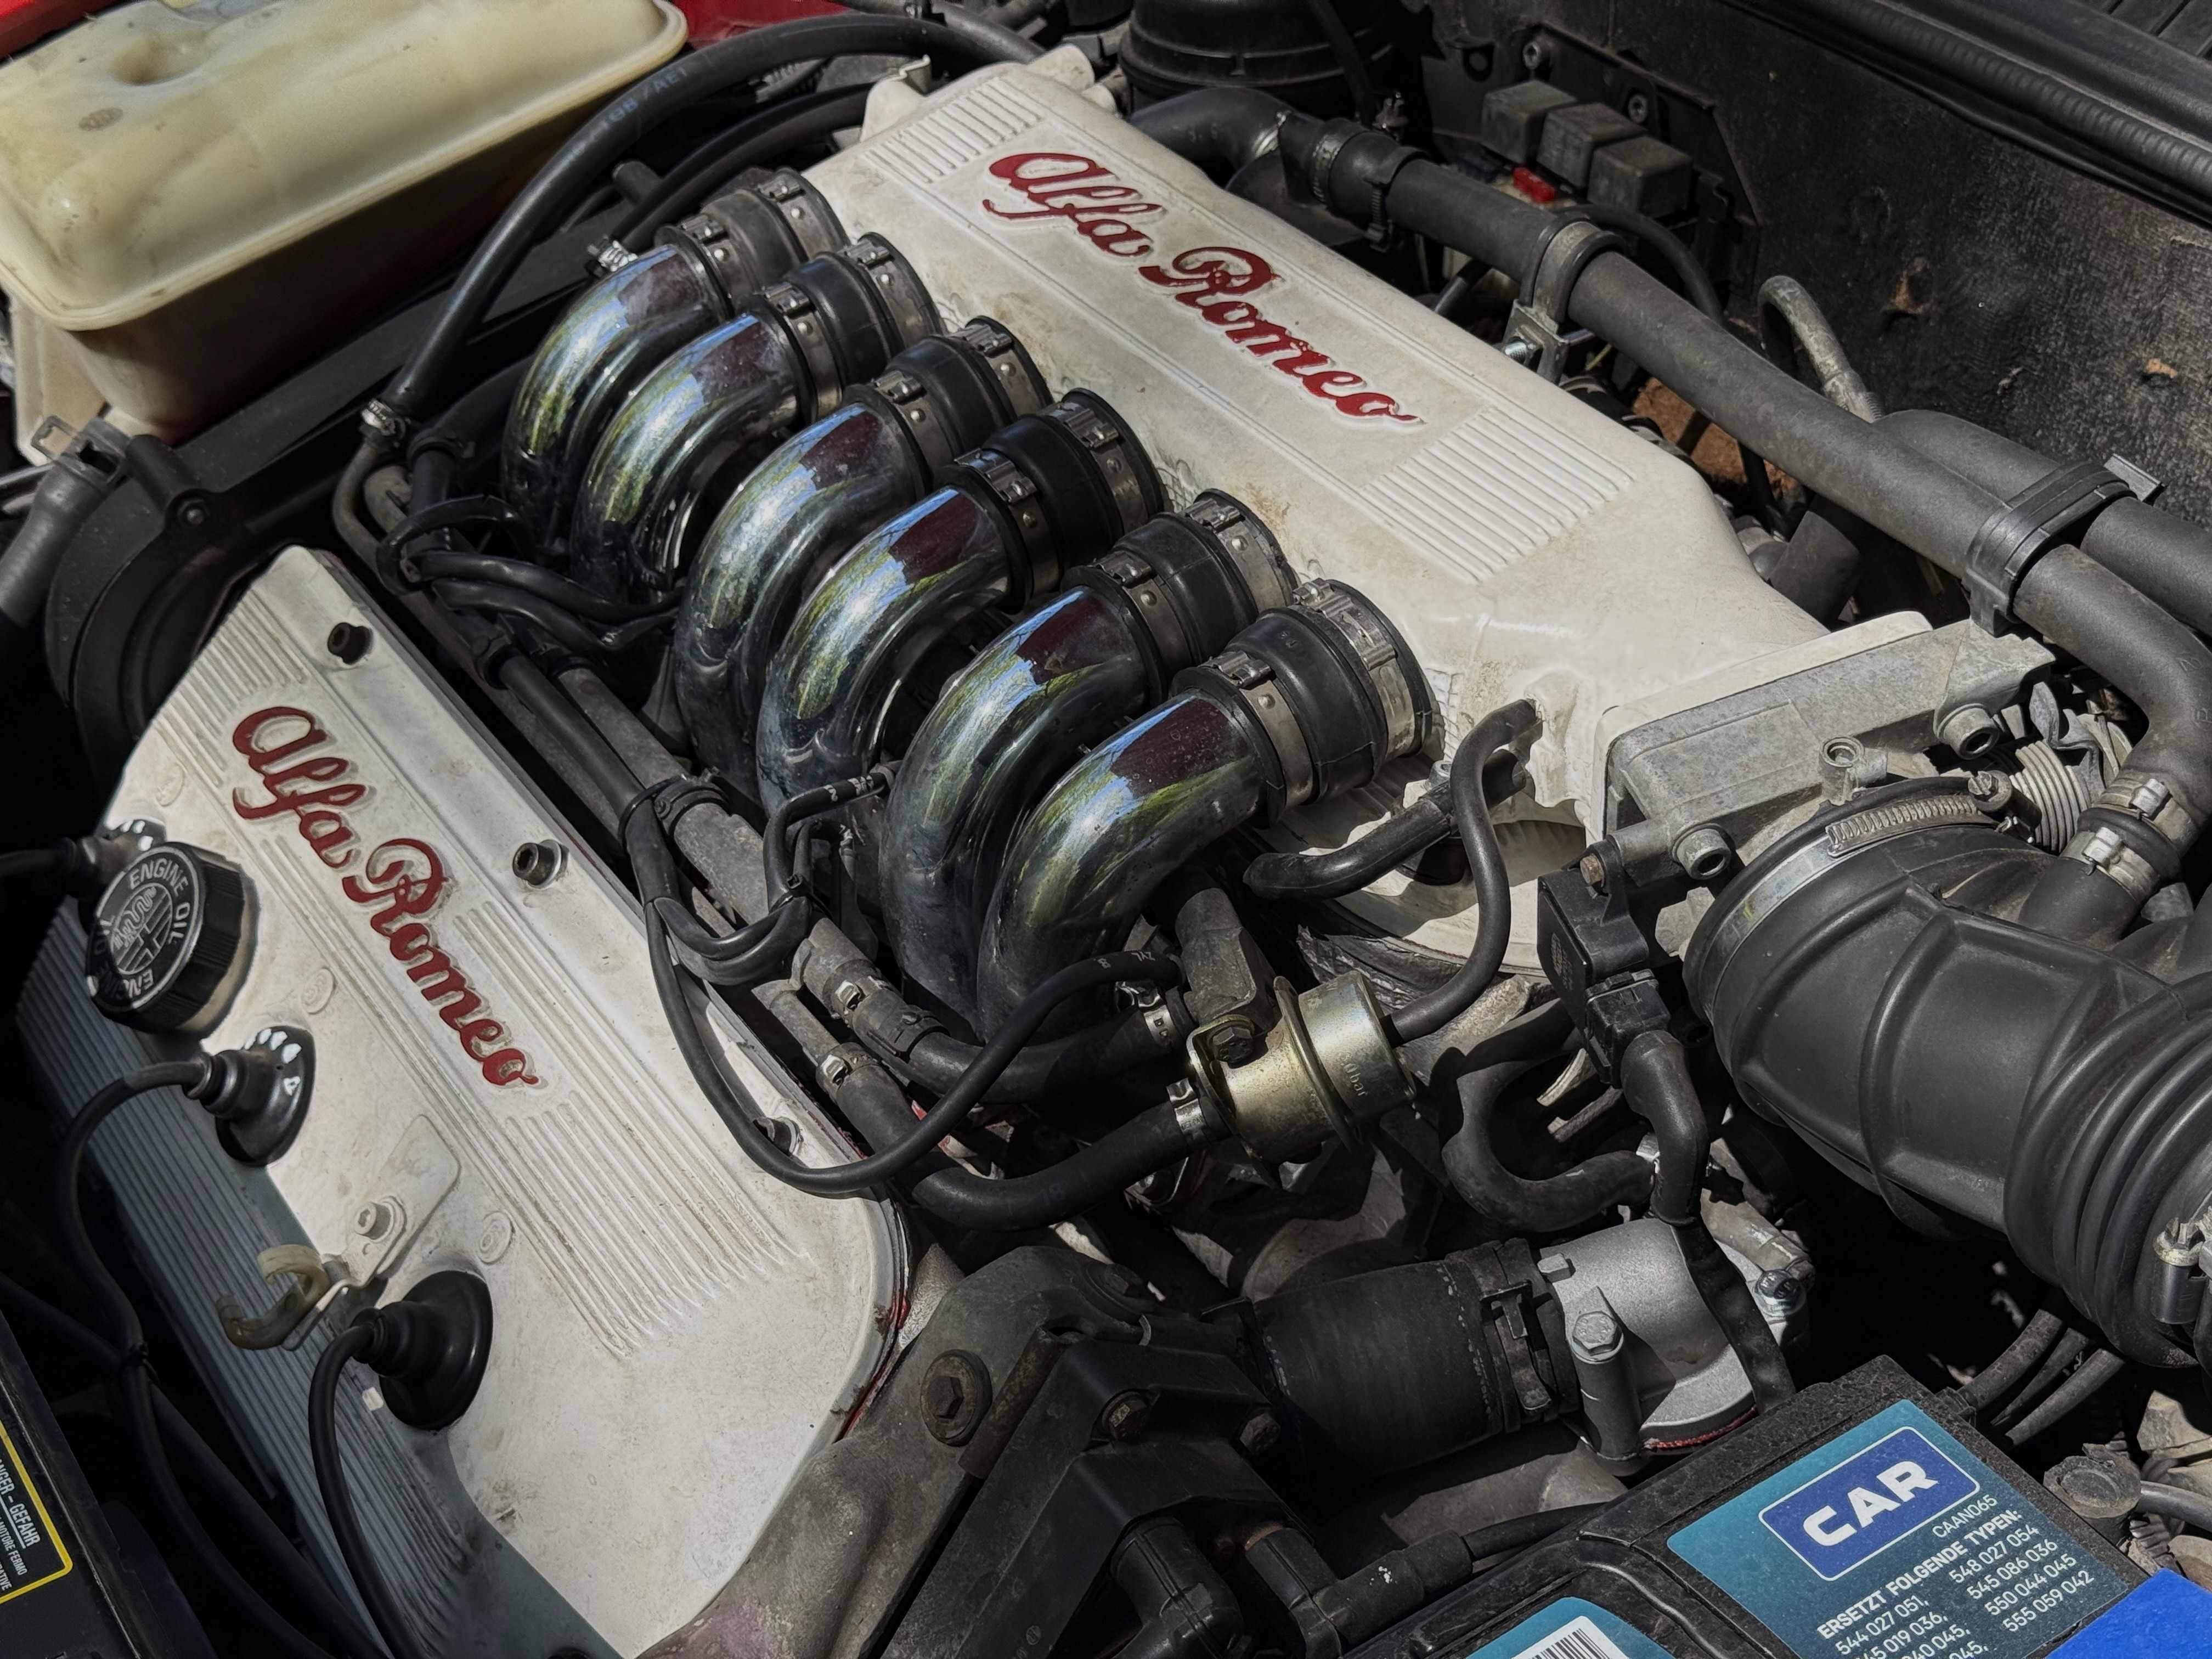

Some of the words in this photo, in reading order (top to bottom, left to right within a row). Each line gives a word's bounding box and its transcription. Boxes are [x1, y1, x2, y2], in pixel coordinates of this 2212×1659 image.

[983, 153, 1162, 256] Alfa
[1139, 246, 1426, 424] Romeo
[129, 858, 188, 896] ENGINE
[168, 902, 190, 944] OIL
[233, 706, 366, 868] Alfa
[342, 838, 539, 1085] Romeo
[9, 1503, 41, 1547] GEFAHR
[1803, 1460, 1938, 1546] CAR
[1932, 1494, 1997, 1538] CAAN065
[8, 1550, 27, 1576] FERMO
[1817, 1590, 1887, 1639] ERSETZT
[1886, 1541, 1968, 1596] FOLGENDE
[1964, 1509, 2022, 1545] TYPEN:
[1836, 1631, 1869, 1655] 544
[1866, 1611, 1895, 1635] 027
[1894, 1595, 1929, 1617] 051,
[1949, 1559, 1982, 1583] 548
[1978, 1541, 2007, 1564] 027
[2006, 1525, 2039, 1547] 054
[1883, 1630, 1911, 1652] 019
[1909, 1612, 1948, 1635] 036,
[1967, 1575, 2000, 1599] 545
[1997, 1558, 2029, 1581] 086
[2025, 1539, 2058, 1562] 036
[1932, 1624, 1971, 1649] 045,
[1984, 1591, 2018, 1615] 550
[2015, 1573, 2047, 1596] 044
[2043, 1554, 2076, 1578] 045
[2003, 1606, 2037, 1632] 555
[2033, 1589, 2063, 1612] 059
[2061, 1570, 2094, 1594] 042
